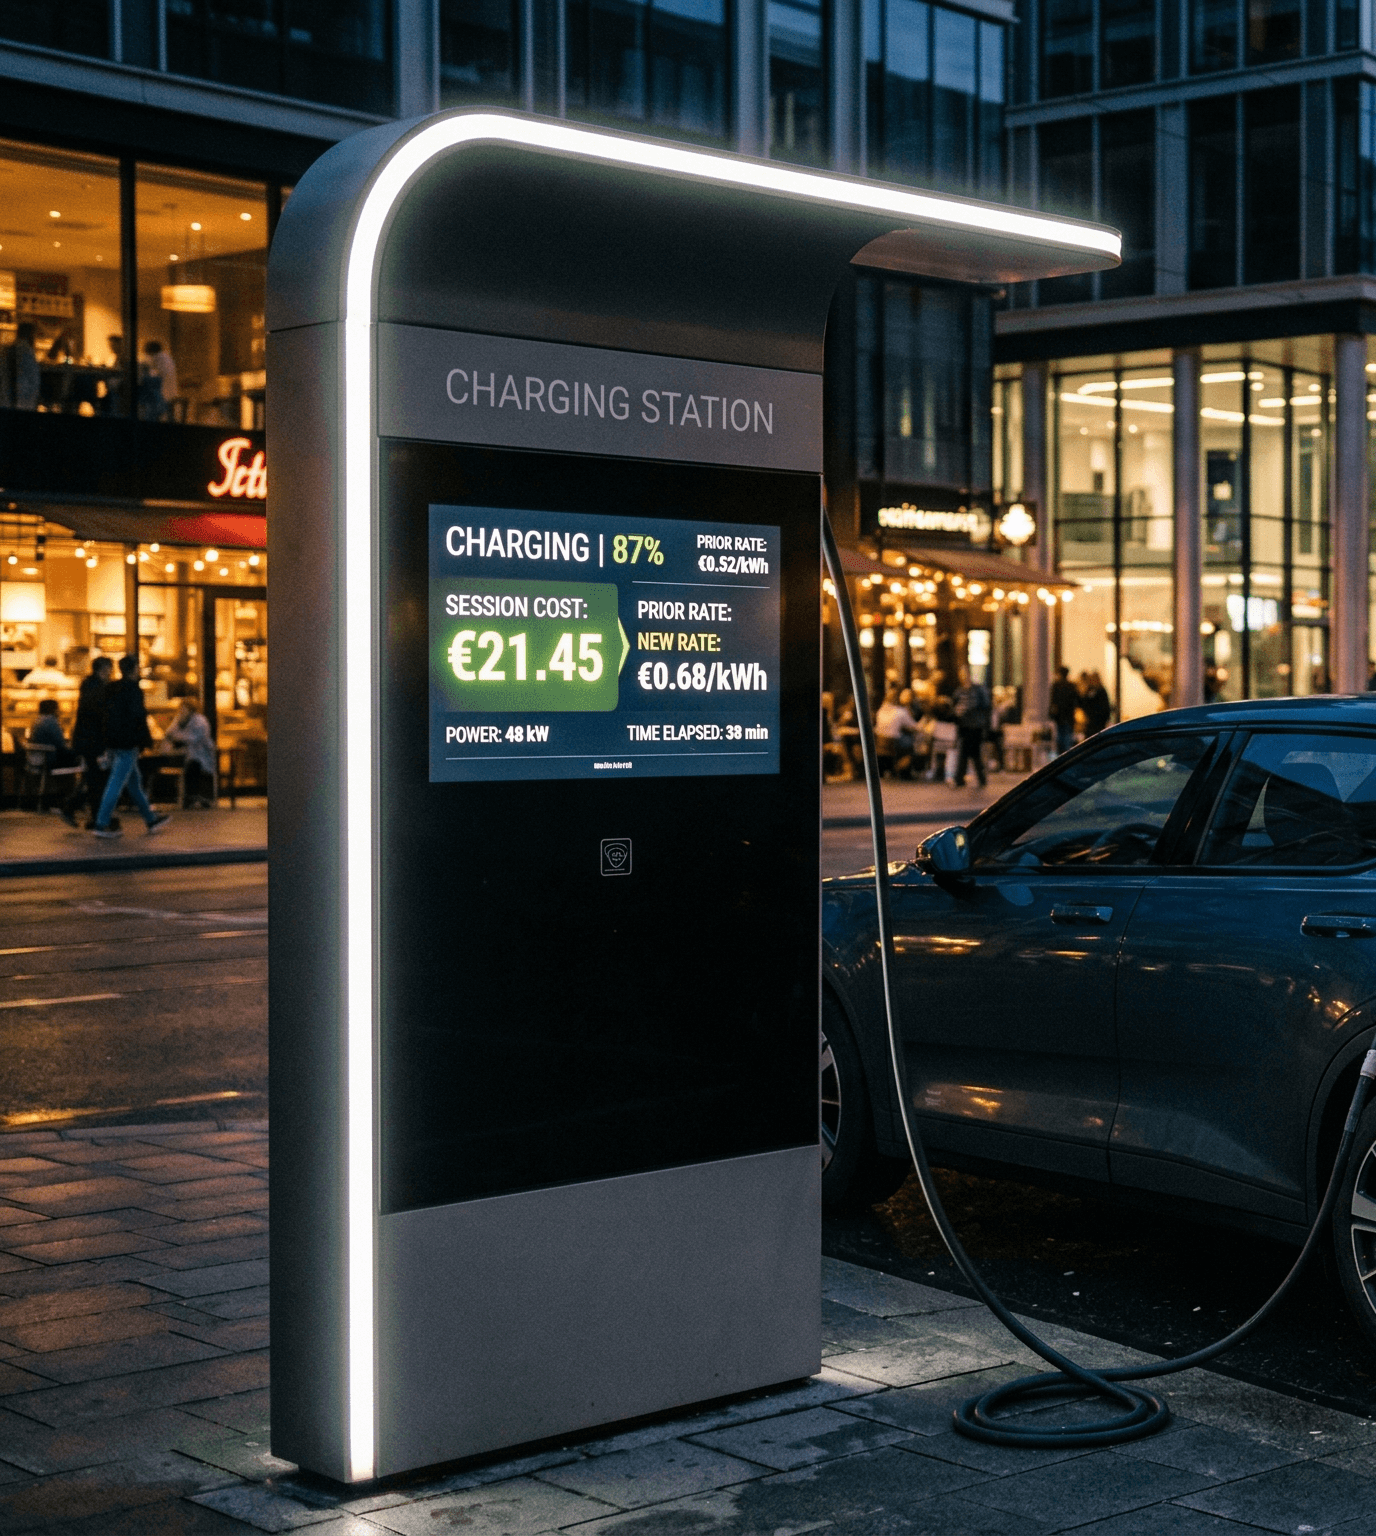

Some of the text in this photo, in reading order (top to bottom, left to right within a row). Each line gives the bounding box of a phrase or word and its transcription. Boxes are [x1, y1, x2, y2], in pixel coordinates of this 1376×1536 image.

[446, 368, 774, 435] CHARGING STATION
[445, 525, 590, 563] CHARGING
[612, 534, 665, 566] 87%
[696, 535, 768, 553] PRIOR RATE:
[445, 593, 588, 619] SESSION COST:
[637, 600, 732, 622] PRIOR RATE:
[637, 631, 722, 652] NEW RATE:
[447, 629, 604, 682] €21.45
[637, 661, 768, 693] €0.68/kWh
[445, 724, 550, 744] POWER: 48 kW
[626, 723, 769, 741] TIME ELAPSED: 38 min
